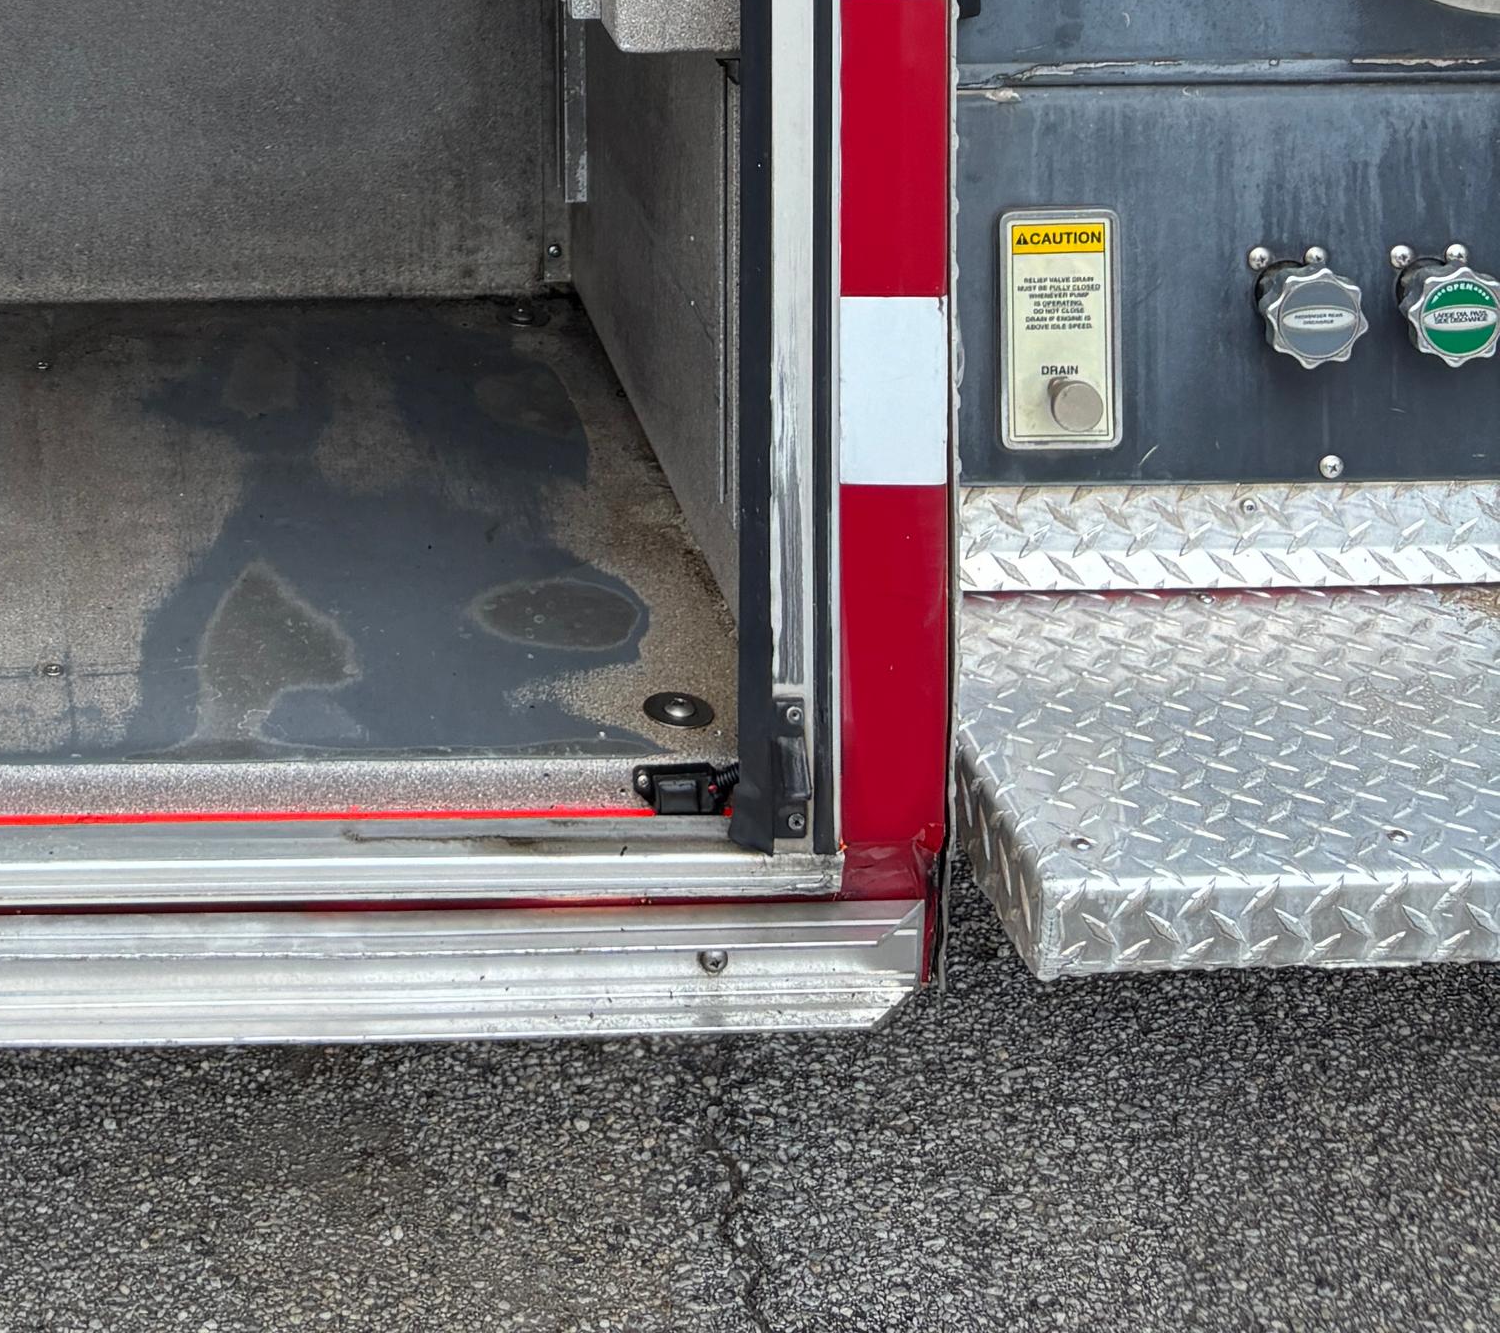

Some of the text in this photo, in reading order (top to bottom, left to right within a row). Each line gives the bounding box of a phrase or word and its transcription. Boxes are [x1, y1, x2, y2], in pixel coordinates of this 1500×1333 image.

[1029, 231, 1102, 245] CAUTION
[1072, 283, 1101, 291] CLOSED
[1446, 282, 1474, 292] OPEN
[1025, 323, 1050, 331] ABOVE
[1041, 365, 1079, 376] DRAIN
